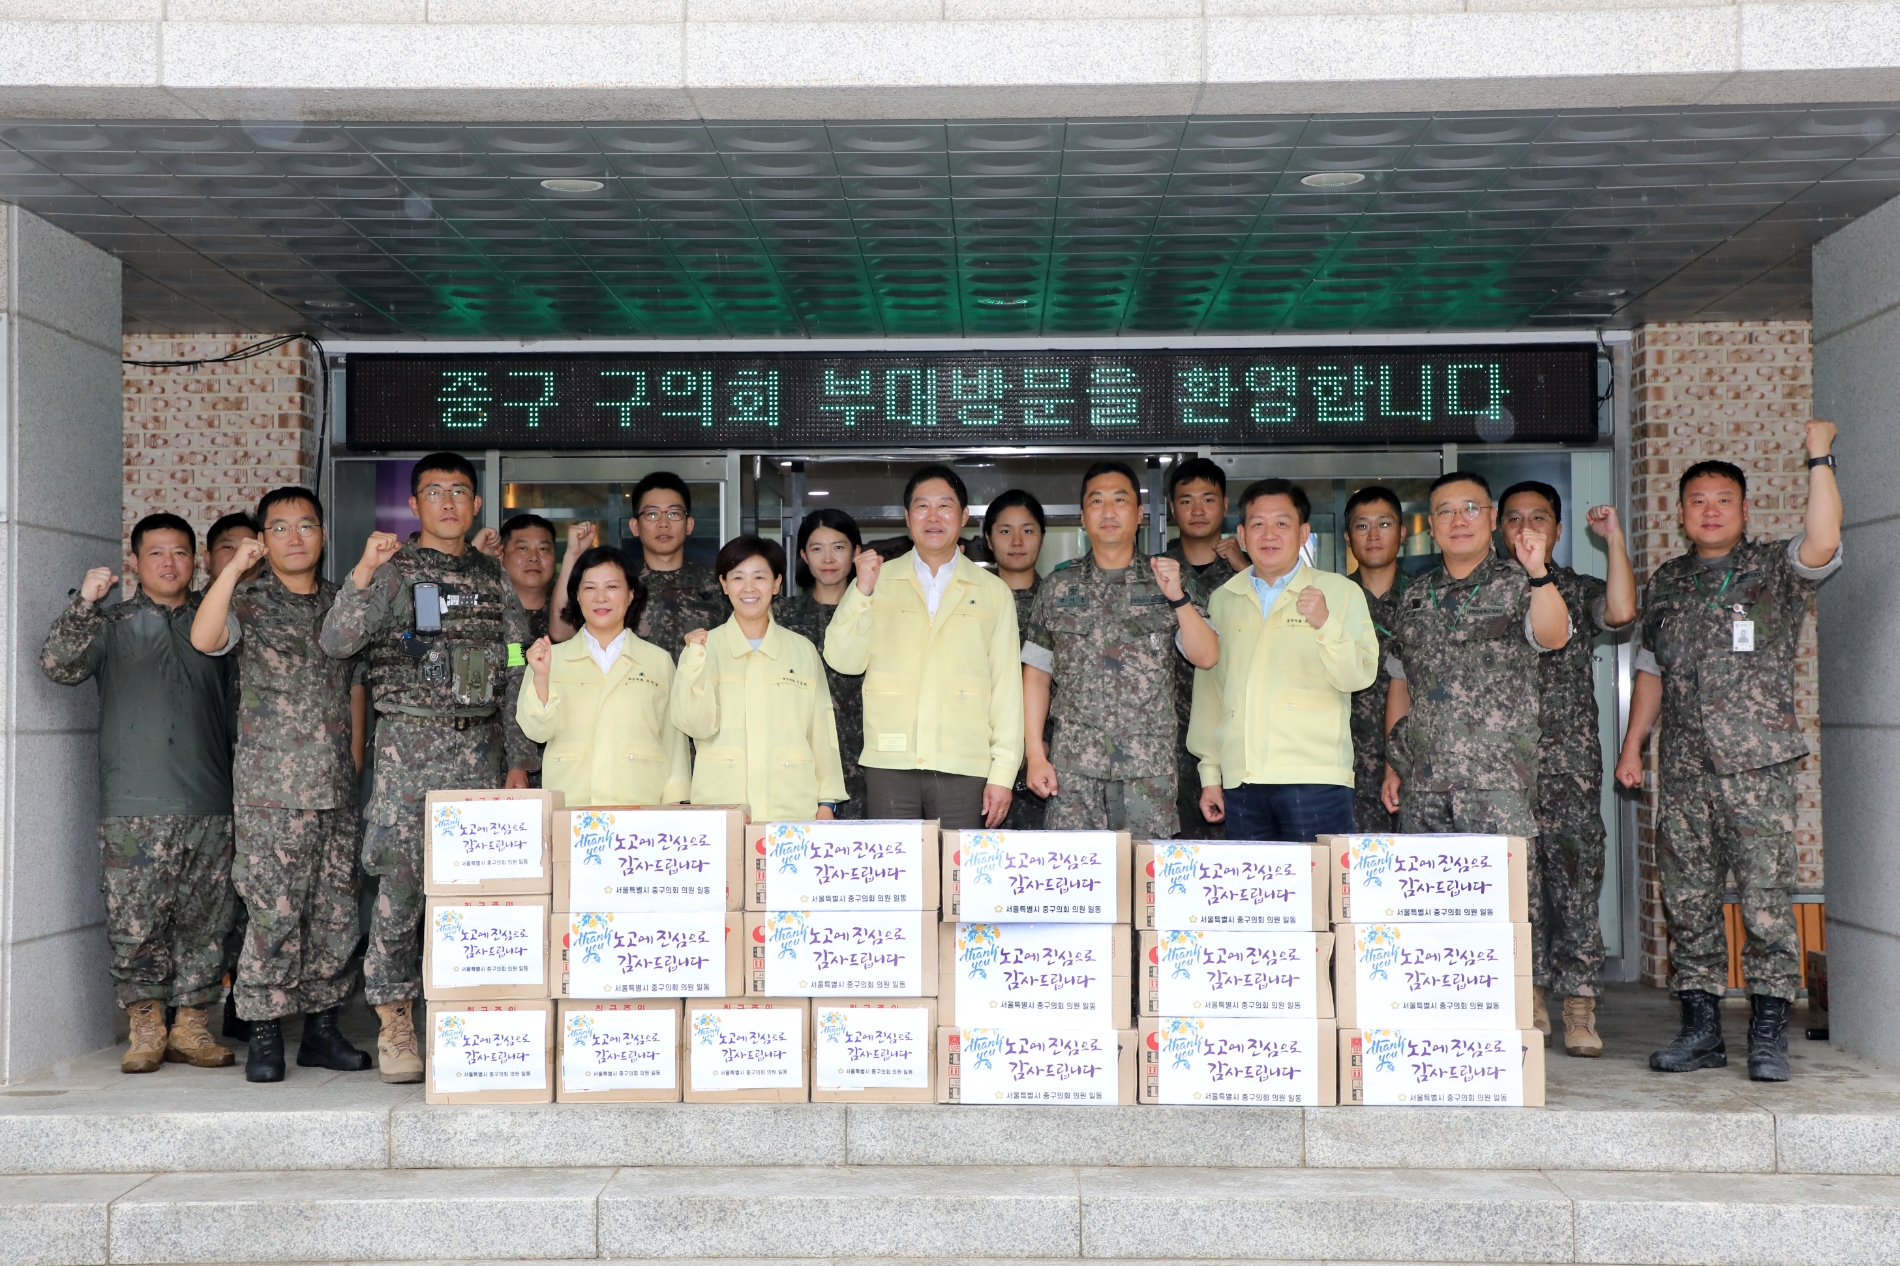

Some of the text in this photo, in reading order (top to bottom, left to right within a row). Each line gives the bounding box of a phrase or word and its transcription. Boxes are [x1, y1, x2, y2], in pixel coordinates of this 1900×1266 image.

[438, 371, 558, 428] 중구
[595, 370, 780, 428] 구의회
[1177, 364, 1512, 426] 환영합니다
[460, 822, 527, 836] 노고에 진심으로
[463, 837, 527, 853] 감사드립니다
[615, 833, 711, 851] 노고에 진심으로
[810, 841, 907, 859] 노고에 진심으로
[618, 856, 710, 875] 감사드립니다
[1005, 852, 1102, 870] 노고에 진심으로
[1394, 855, 1493, 873] 노고에 진심으로
[814, 864, 906, 884] 감사드립니다
[1199, 862, 1296, 881] 노고에 진심으로
[616, 886, 711, 894] 서울특별시 중구의회 의원 일동
[1009, 875, 1101, 894] 감사드립니다
[1399, 878, 1493, 897] 감사드립니다
[812, 894, 907, 903] 서울특별시 중구의회 의원 일동
[1203, 885, 1296, 905] 감사드립니다
[1006, 905, 1102, 914] 서울특별시 중구의회 의원 일동
[1397, 908, 1494, 917] 서울특별시 중구의회 의원 일동
[1201, 916, 1296, 924] 서울특별시 중구의회 의원 일동
[461, 928, 528, 941] 노고에 진심으로
[613, 930, 710, 948] 노고에 진심으로
[809, 927, 906, 945] 노고에 진심으로
[463, 944, 528, 958] 감사드립니다
[813, 950, 906, 969] 감사드립니다
[1000, 948, 1096, 967] 노고에 진심으로
[1203, 947, 1301, 966] 노고에 진심으로
[1400, 948, 1499, 966] 노고에 진심으로
[617, 953, 710, 973] 감사드립니다
[615, 983, 710, 993] 서울특별시 중구의회 의원 일동
[811, 980, 906, 989] 서울특별시 중구의회 의원 일동
[1003, 970, 1096, 991] 감사드립니다
[1207, 970, 1300, 990] 감사드립니다
[1405, 971, 1499, 991] 감사드립니다
[1001, 1001, 1096, 1010] 서울특별시 중구의회 의원 일동
[1205, 1001, 1301, 1010] 서울특별시 중구의회 의원 일동
[1403, 1002, 1500, 1010] 서울특별시 중구의회 의원 일동
[462, 1033, 530, 1047] 노고에 진심으로
[592, 1032, 660, 1046] 노고에 진심으로
[719, 1031, 787, 1045] 노고에 진심으로
[845, 1031, 913, 1044] 노고에 진심으로
[595, 1048, 660, 1063] 감사드립니다
[722, 1048, 787, 1062] 감사드립니다
[848, 1047, 912, 1061] 감사드립니다
[1005, 1038, 1102, 1056] 노고에 진심으로
[1204, 1039, 1302, 1058] 노고에 진심으로
[1407, 1039, 1506, 1058] 노고에 진심으로
[465, 1049, 530, 1064] 감사드립니다
[1009, 1061, 1102, 1081] 감사드립니다
[1208, 1061, 1301, 1083] 감사드립니다
[1412, 1063, 1507, 1083] 감사드립니다
[1006, 1091, 1103, 1100] 서울특별시 중구의회 의원 일동
[1205, 1092, 1302, 1103] 서울특별시 중구의회 의원 일동
[1410, 1094, 1508, 1102] 서울특별시 중구의회 의원 일동
